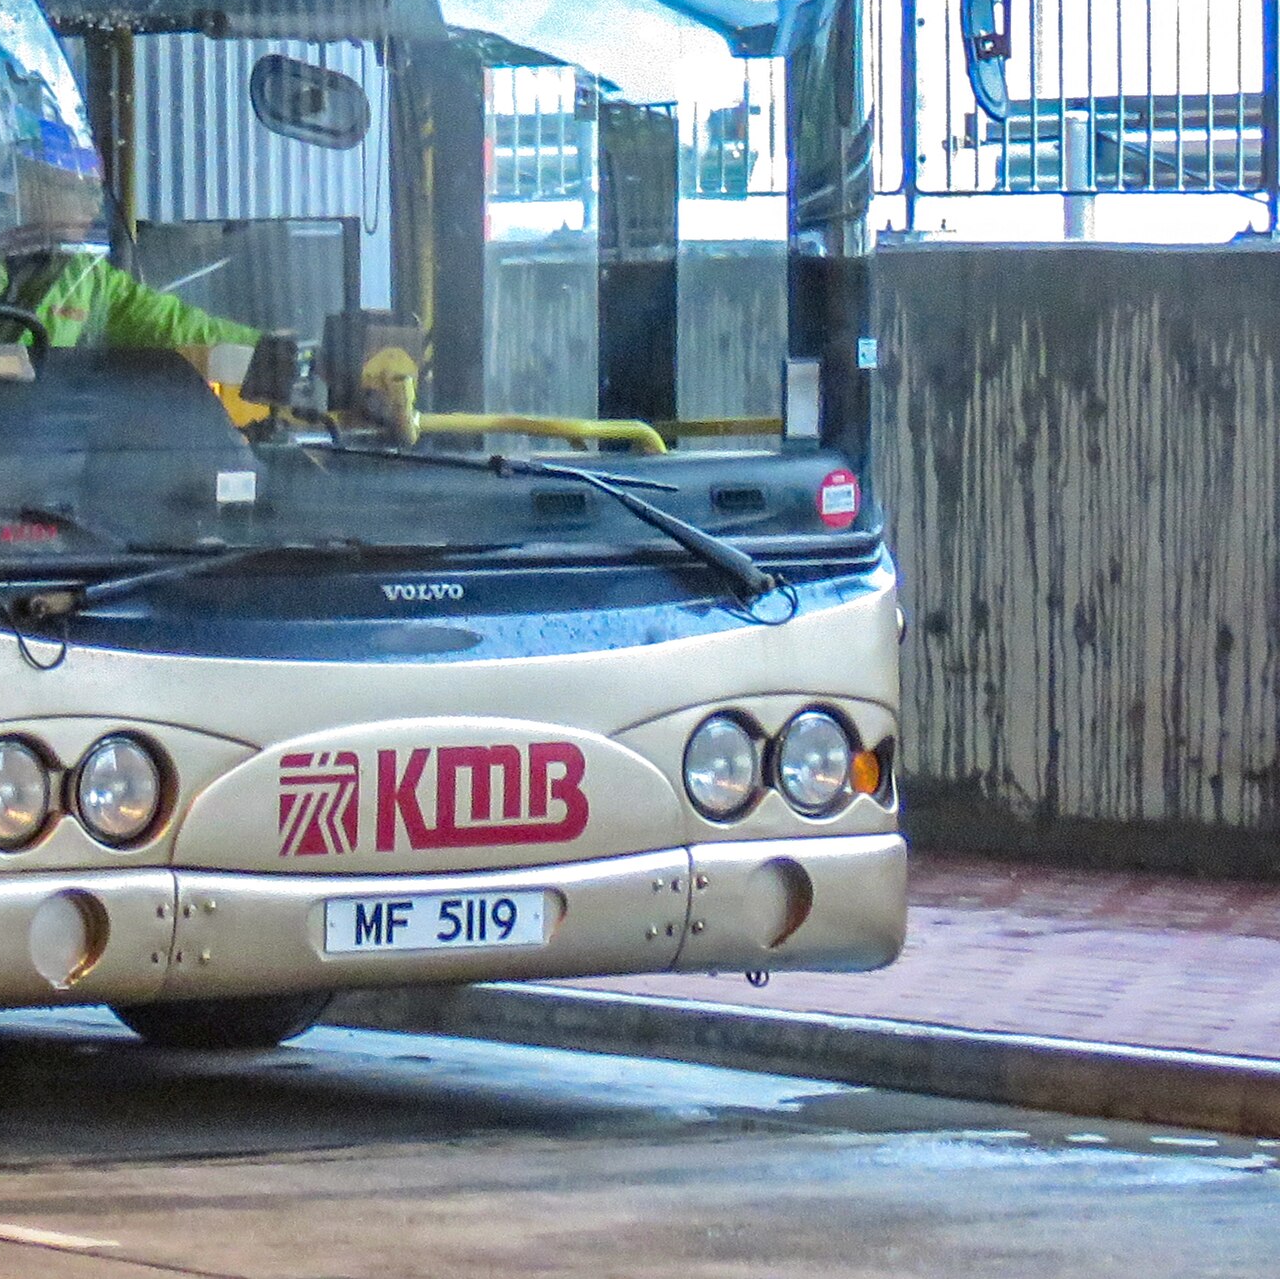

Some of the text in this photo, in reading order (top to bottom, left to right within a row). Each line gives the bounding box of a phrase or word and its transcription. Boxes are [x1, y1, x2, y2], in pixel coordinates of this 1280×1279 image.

[381, 582, 466, 601] VOLVO
[375, 740, 590, 853] KMB
[354, 897, 519, 947] MF 5119
